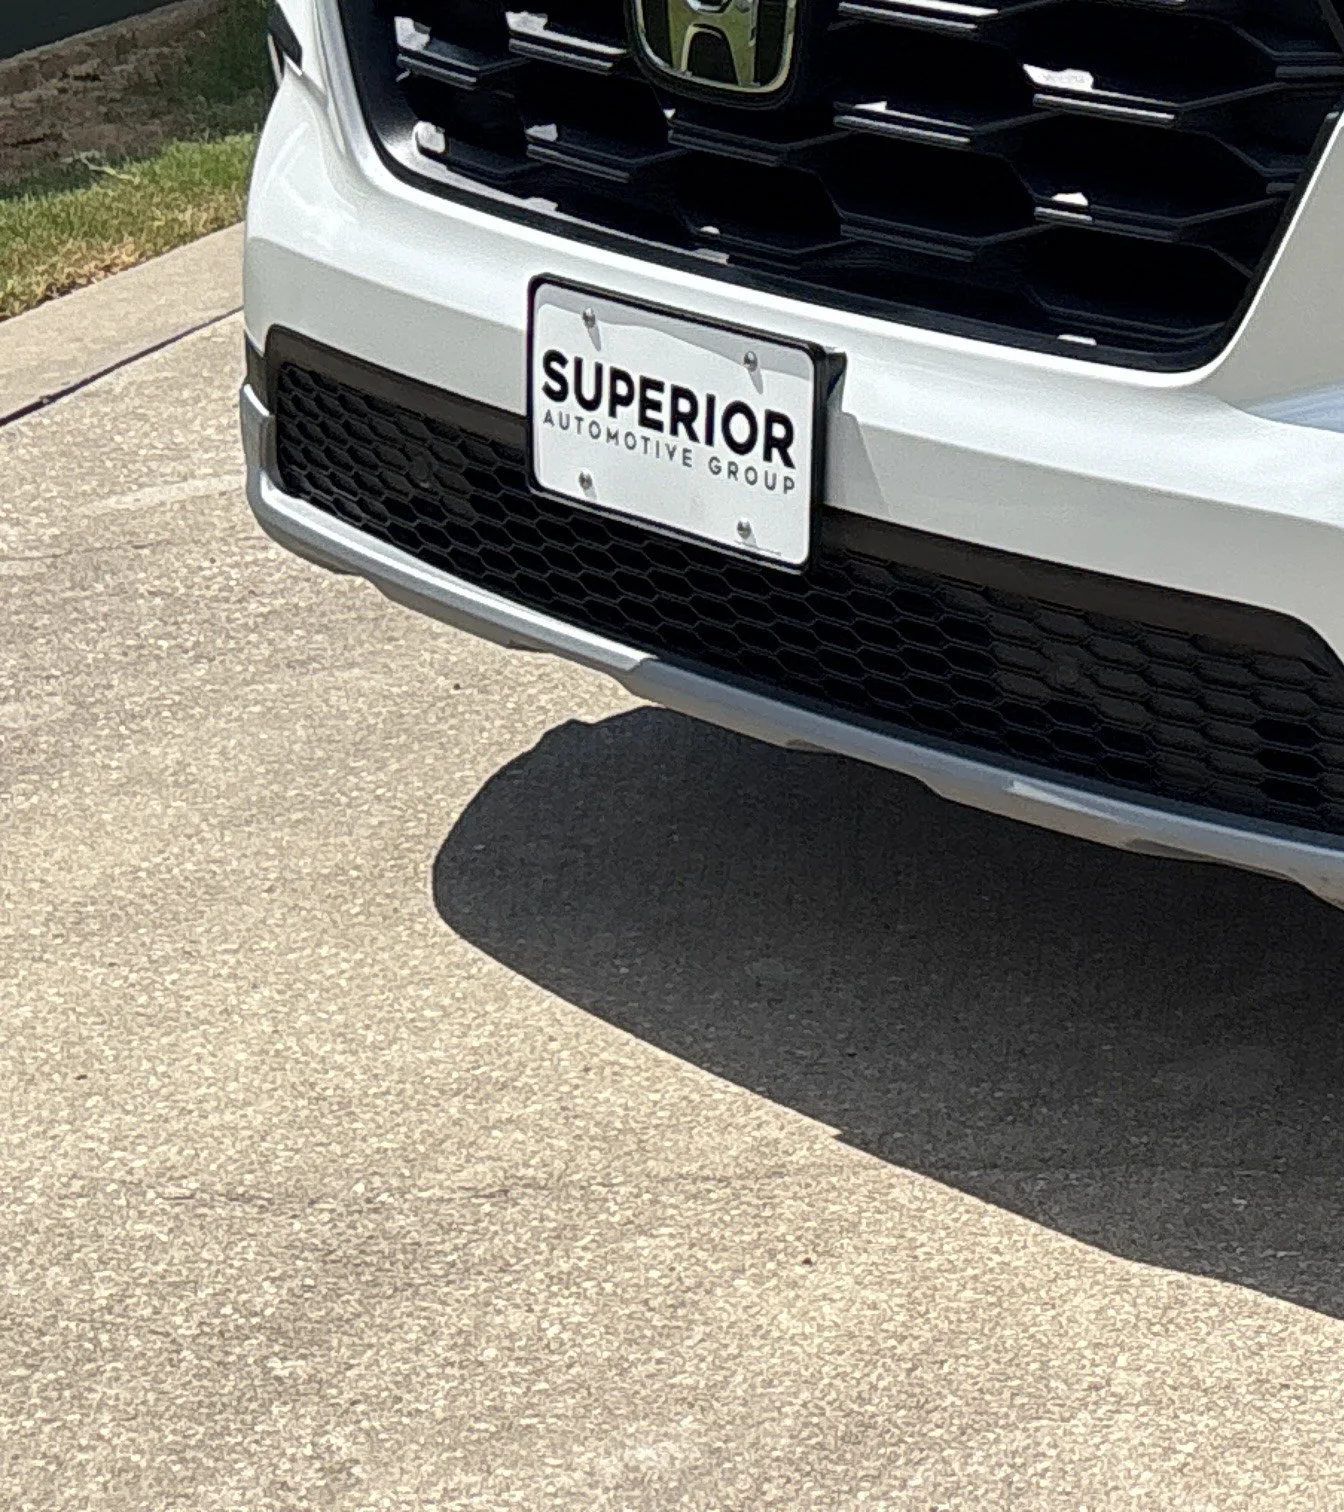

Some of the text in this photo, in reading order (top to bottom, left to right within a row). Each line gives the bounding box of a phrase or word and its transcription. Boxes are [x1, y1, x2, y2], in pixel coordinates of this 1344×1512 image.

[541, 349, 796, 470] SUPERIOR
[542, 409, 796, 495] AUTOMOTIVE GROUP
